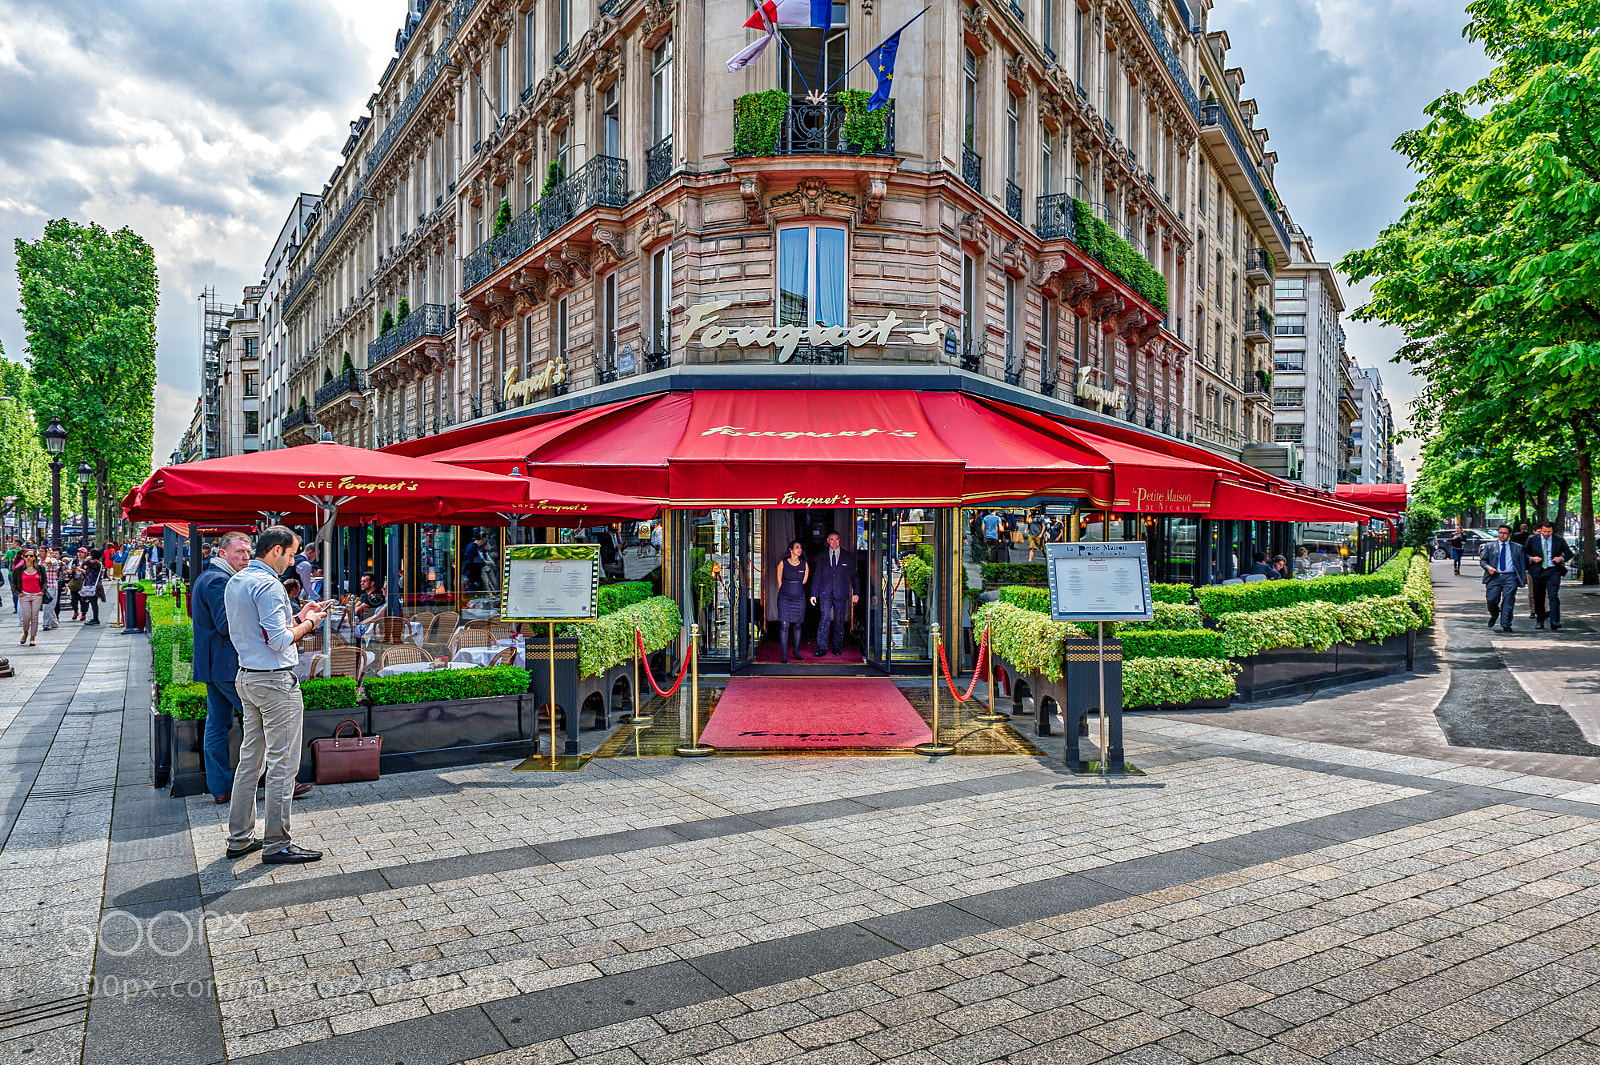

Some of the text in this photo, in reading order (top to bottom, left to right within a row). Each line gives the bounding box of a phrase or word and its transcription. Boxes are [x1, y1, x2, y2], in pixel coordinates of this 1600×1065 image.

[680, 299, 945, 363] Fouquet's
[503, 356, 567, 406] Fouquet's
[701, 425, 918, 440] Fouquet's
[298, 475, 419, 494] CAFE Fouquet's
[781, 491, 851, 507] Fouquet's
[1136, 487, 1164, 511] Petite
[1166, 488, 1192, 503] Maison
